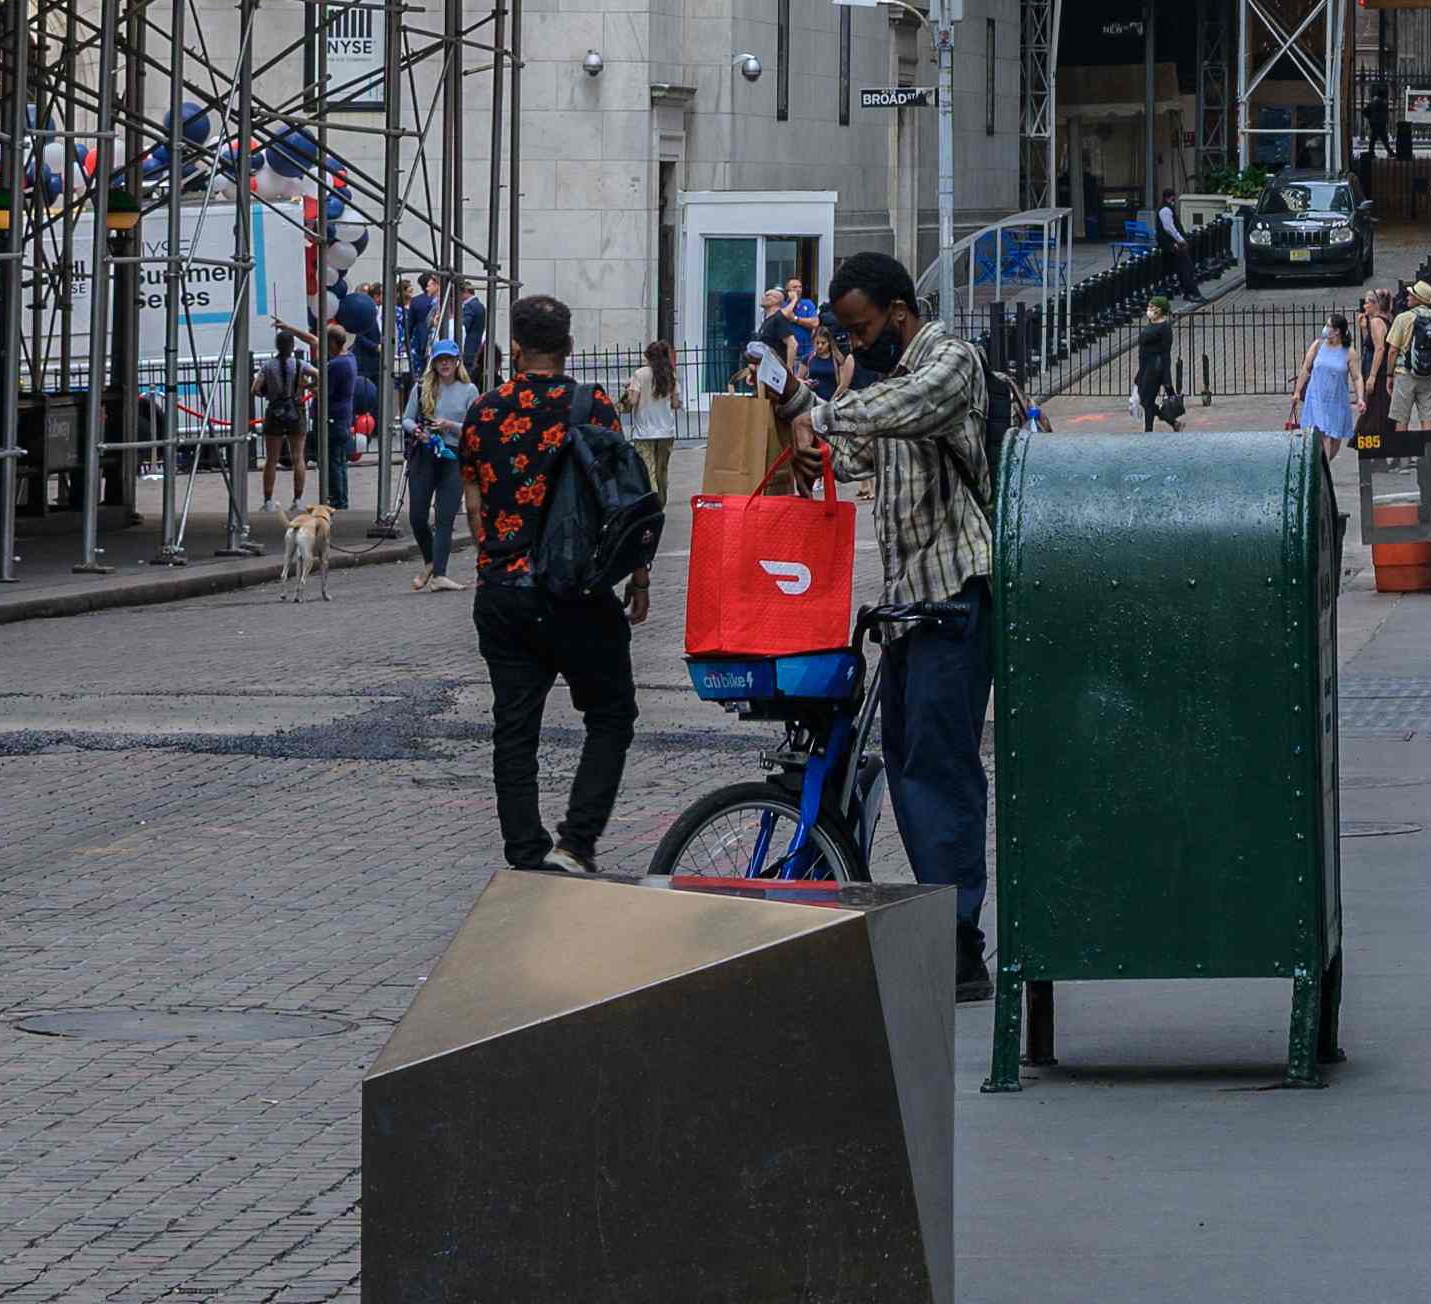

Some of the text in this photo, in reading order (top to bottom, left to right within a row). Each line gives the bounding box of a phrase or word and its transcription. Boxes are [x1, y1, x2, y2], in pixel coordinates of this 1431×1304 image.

[327, 40, 372, 54] NYSE
[863, 93, 906, 105] BROAD
[1357, 435, 1381, 449] 685
